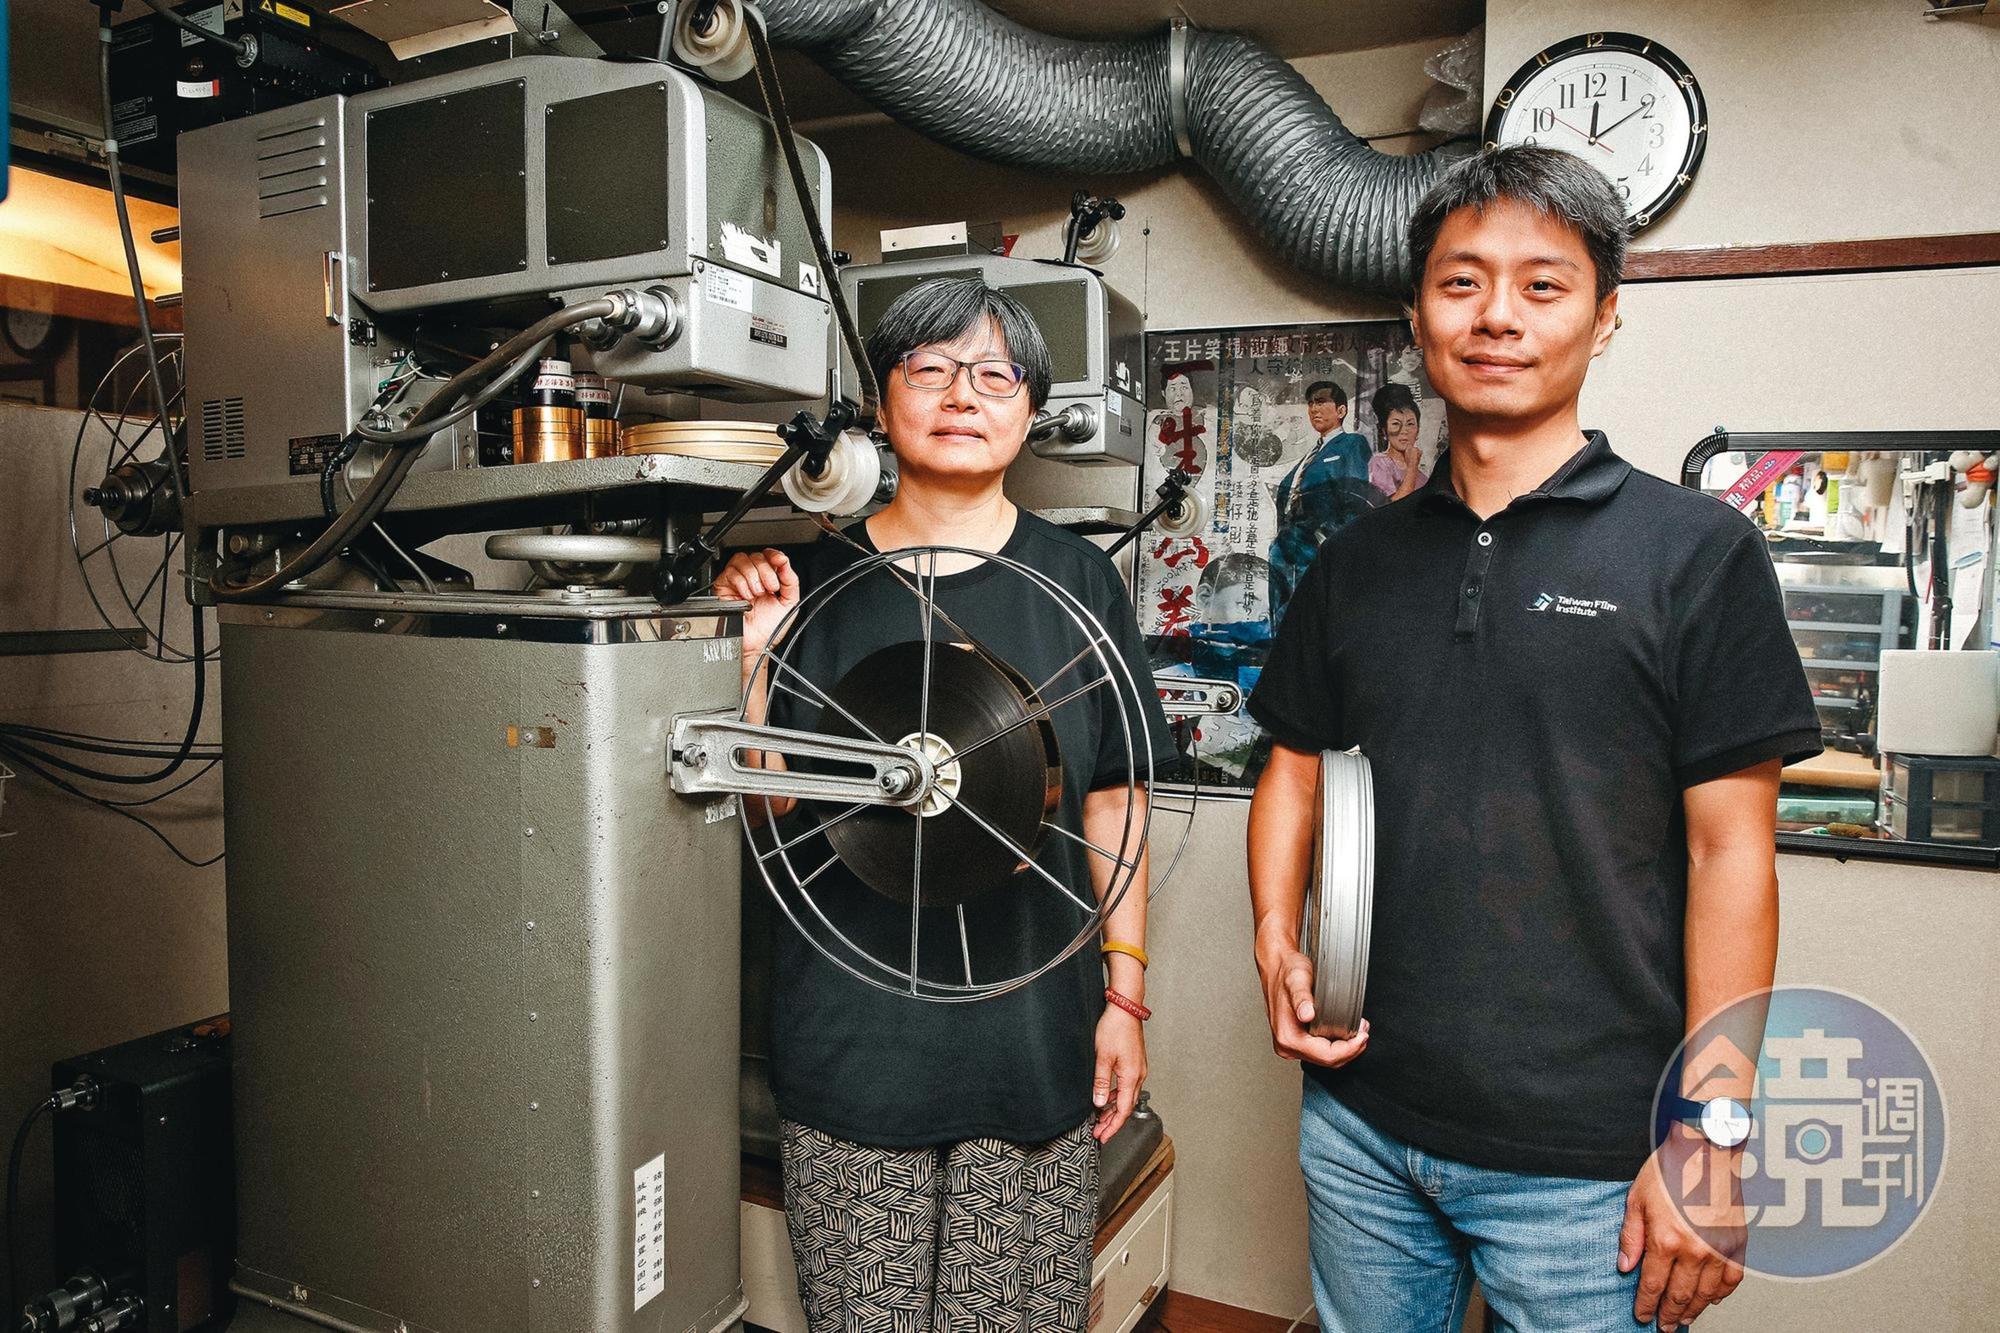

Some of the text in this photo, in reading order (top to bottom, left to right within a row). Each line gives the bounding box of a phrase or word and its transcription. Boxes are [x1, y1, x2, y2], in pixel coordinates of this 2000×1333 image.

[226, 0, 241, 15] A
[1586, 32, 1604, 48] 12
[1583, 72, 1607, 99] 12
[1620, 75, 1628, 102] 1
[1677, 74, 1694, 89] 2
[1496, 88, 1516, 109] 10
[1559, 83, 1575, 110] 11
[1640, 93, 1656, 119] 2
[1532, 107, 1555, 133] 10
[1692, 123, 1707, 134] 3
[1649, 123, 1664, 149] 3
[1637, 153, 1654, 177] 4
[1616, 176, 1631, 201] 5
[1676, 172, 1691, 186] 4
[1635, 211, 1650, 226] 5
[800, 272, 815, 288] A
[1555, 604, 1598, 617] Institute
[1557, 595, 1618, 612] Taiwan Film
